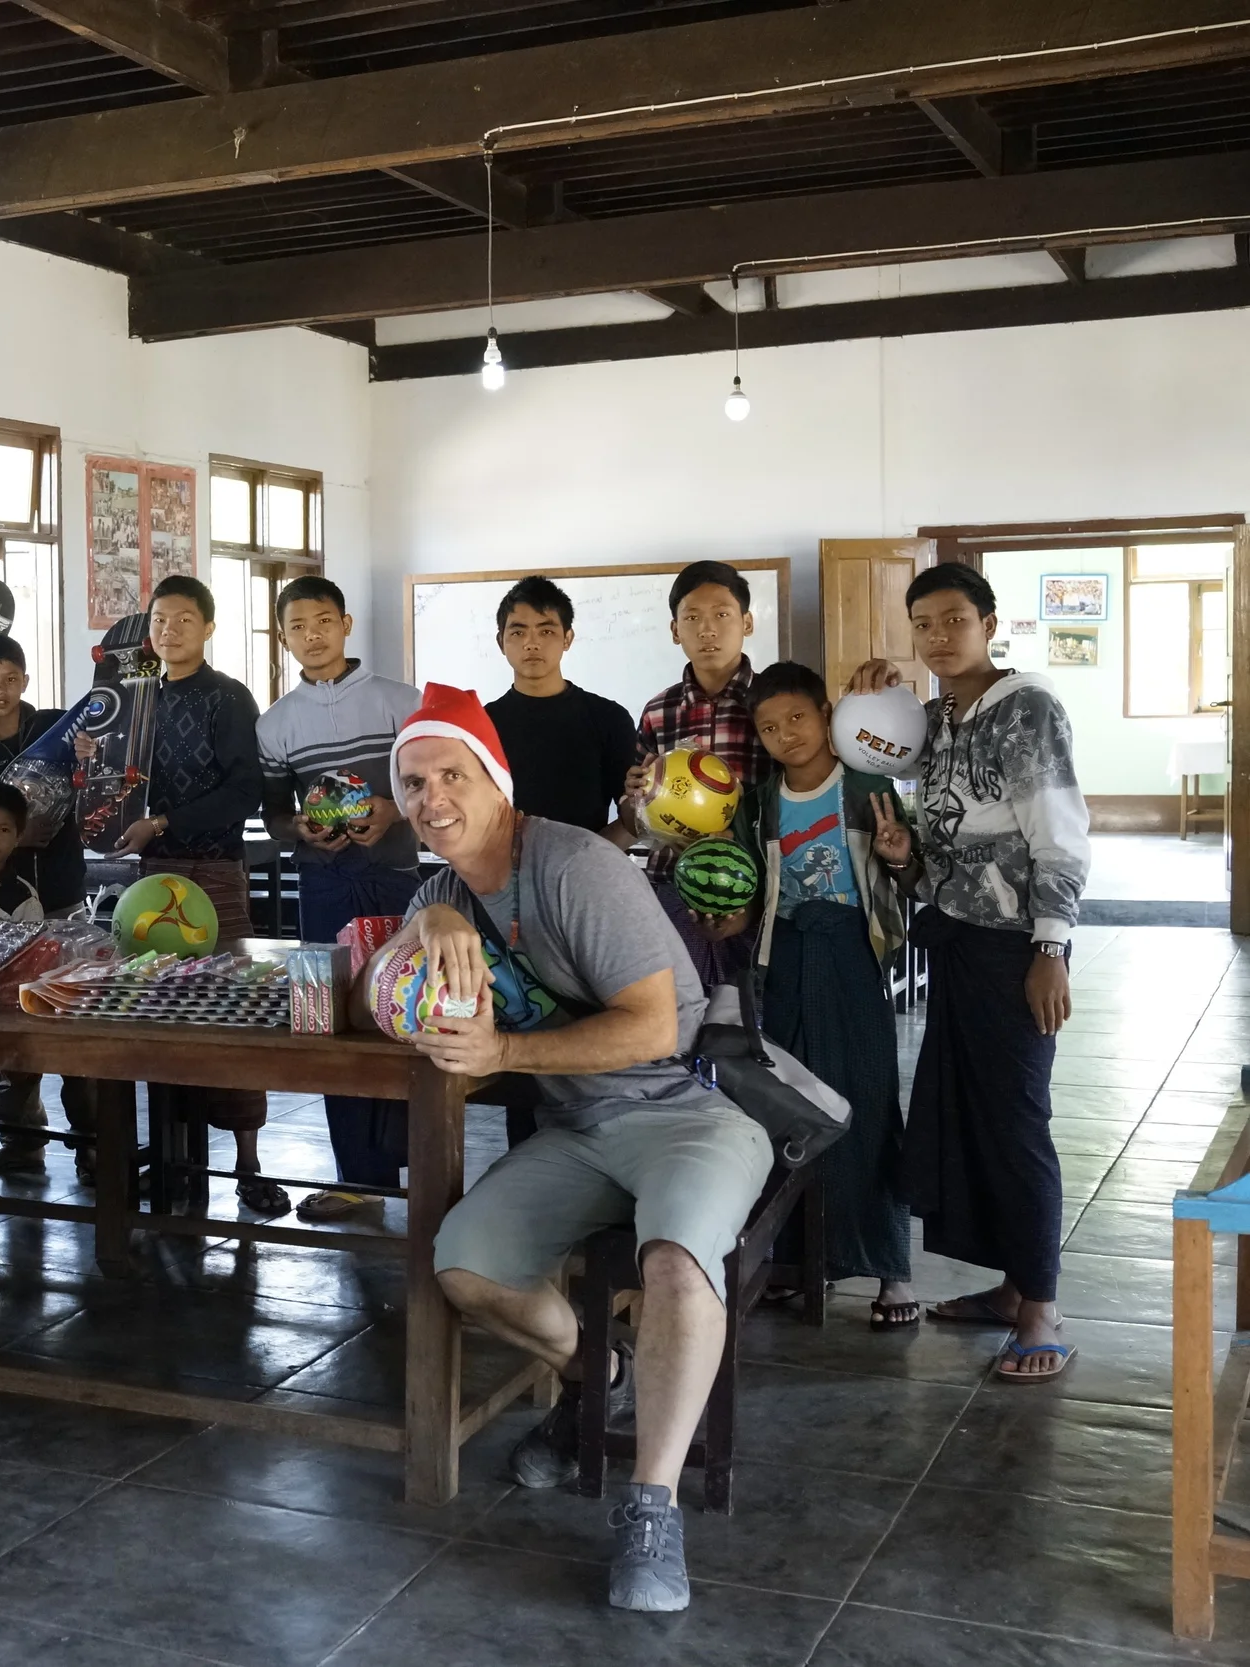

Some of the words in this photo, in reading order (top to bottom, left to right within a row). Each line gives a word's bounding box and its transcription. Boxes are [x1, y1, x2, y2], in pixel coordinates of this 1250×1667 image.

[855, 728, 912, 759] PELF
[858, 746, 880, 762] VOLLEY
[659, 813, 710, 840] ELF
[363, 919, 375, 955] Colgat
[384, 919, 394, 941] Colg
[293, 983, 302, 1032] Colgate
[306, 983, 316, 1032] Colgate
[321, 983, 331, 1031] Colgate
